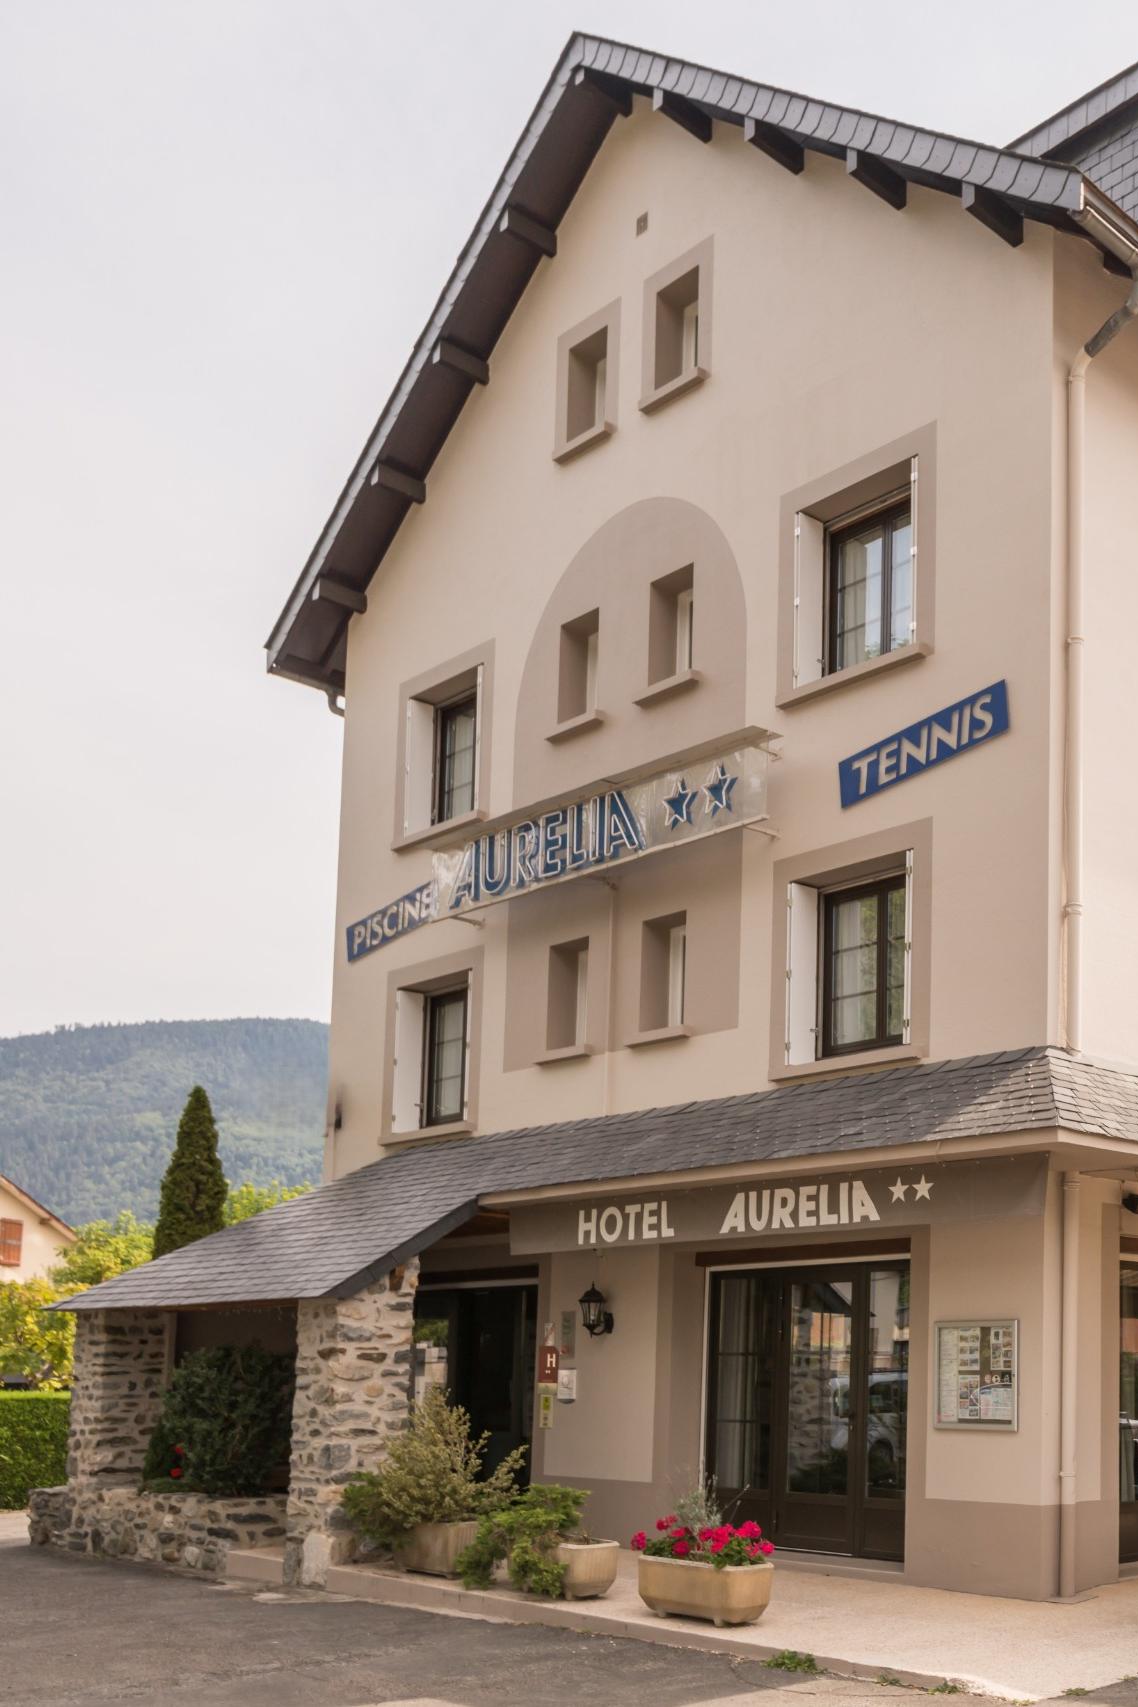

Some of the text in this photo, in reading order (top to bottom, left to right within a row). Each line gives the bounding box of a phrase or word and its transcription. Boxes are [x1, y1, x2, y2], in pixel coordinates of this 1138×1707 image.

[852, 693, 993, 796] TENNIS
[449, 790, 646, 911] AURELIA
[353, 886, 437, 955] PISCINE
[578, 1180, 880, 1245] HOTEL AURELIA
[547, 1353, 556, 1367] H
